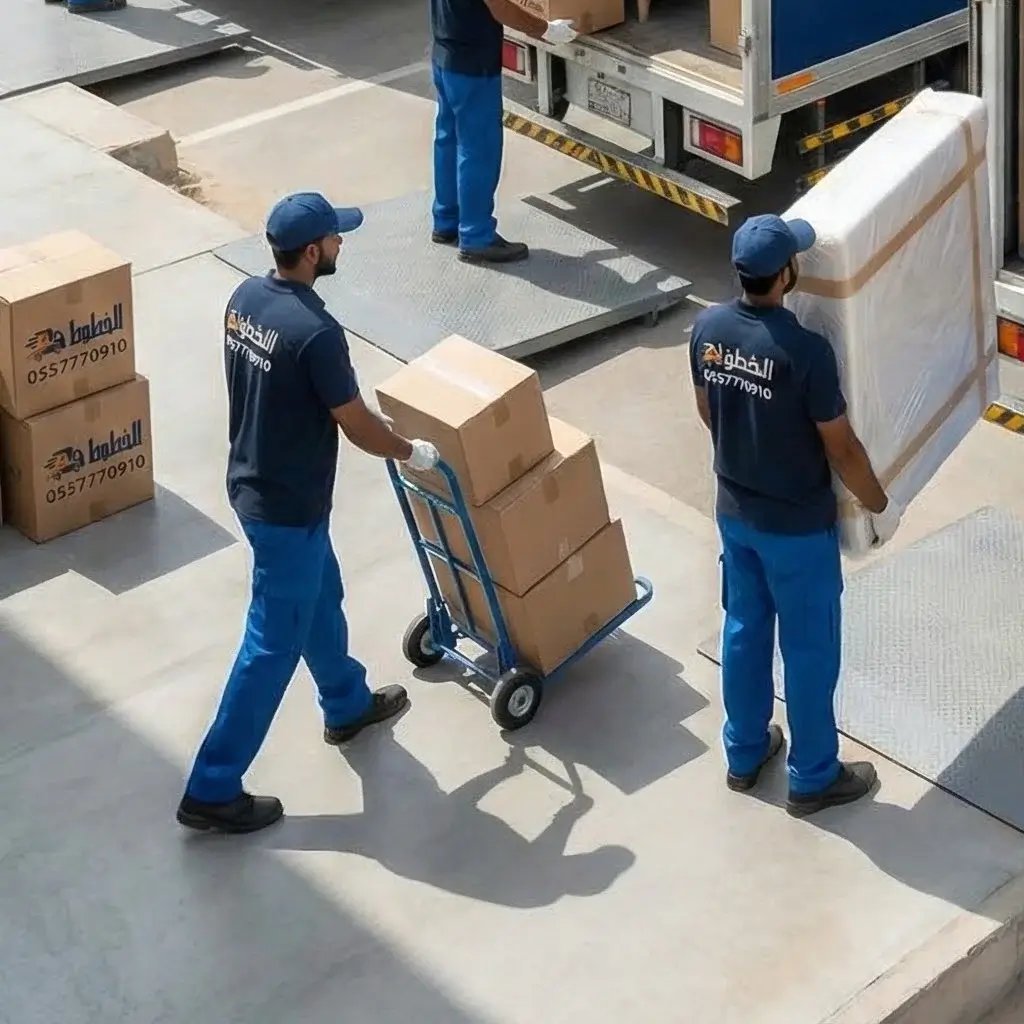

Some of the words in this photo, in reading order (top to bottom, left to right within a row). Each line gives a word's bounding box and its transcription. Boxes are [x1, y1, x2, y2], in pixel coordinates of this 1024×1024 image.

[69, 303, 123, 346] الخطوط
[27, 338, 127, 385] 0557770910
[88, 419, 142, 465] الخطوط
[46, 454, 145, 504] 0557770910
